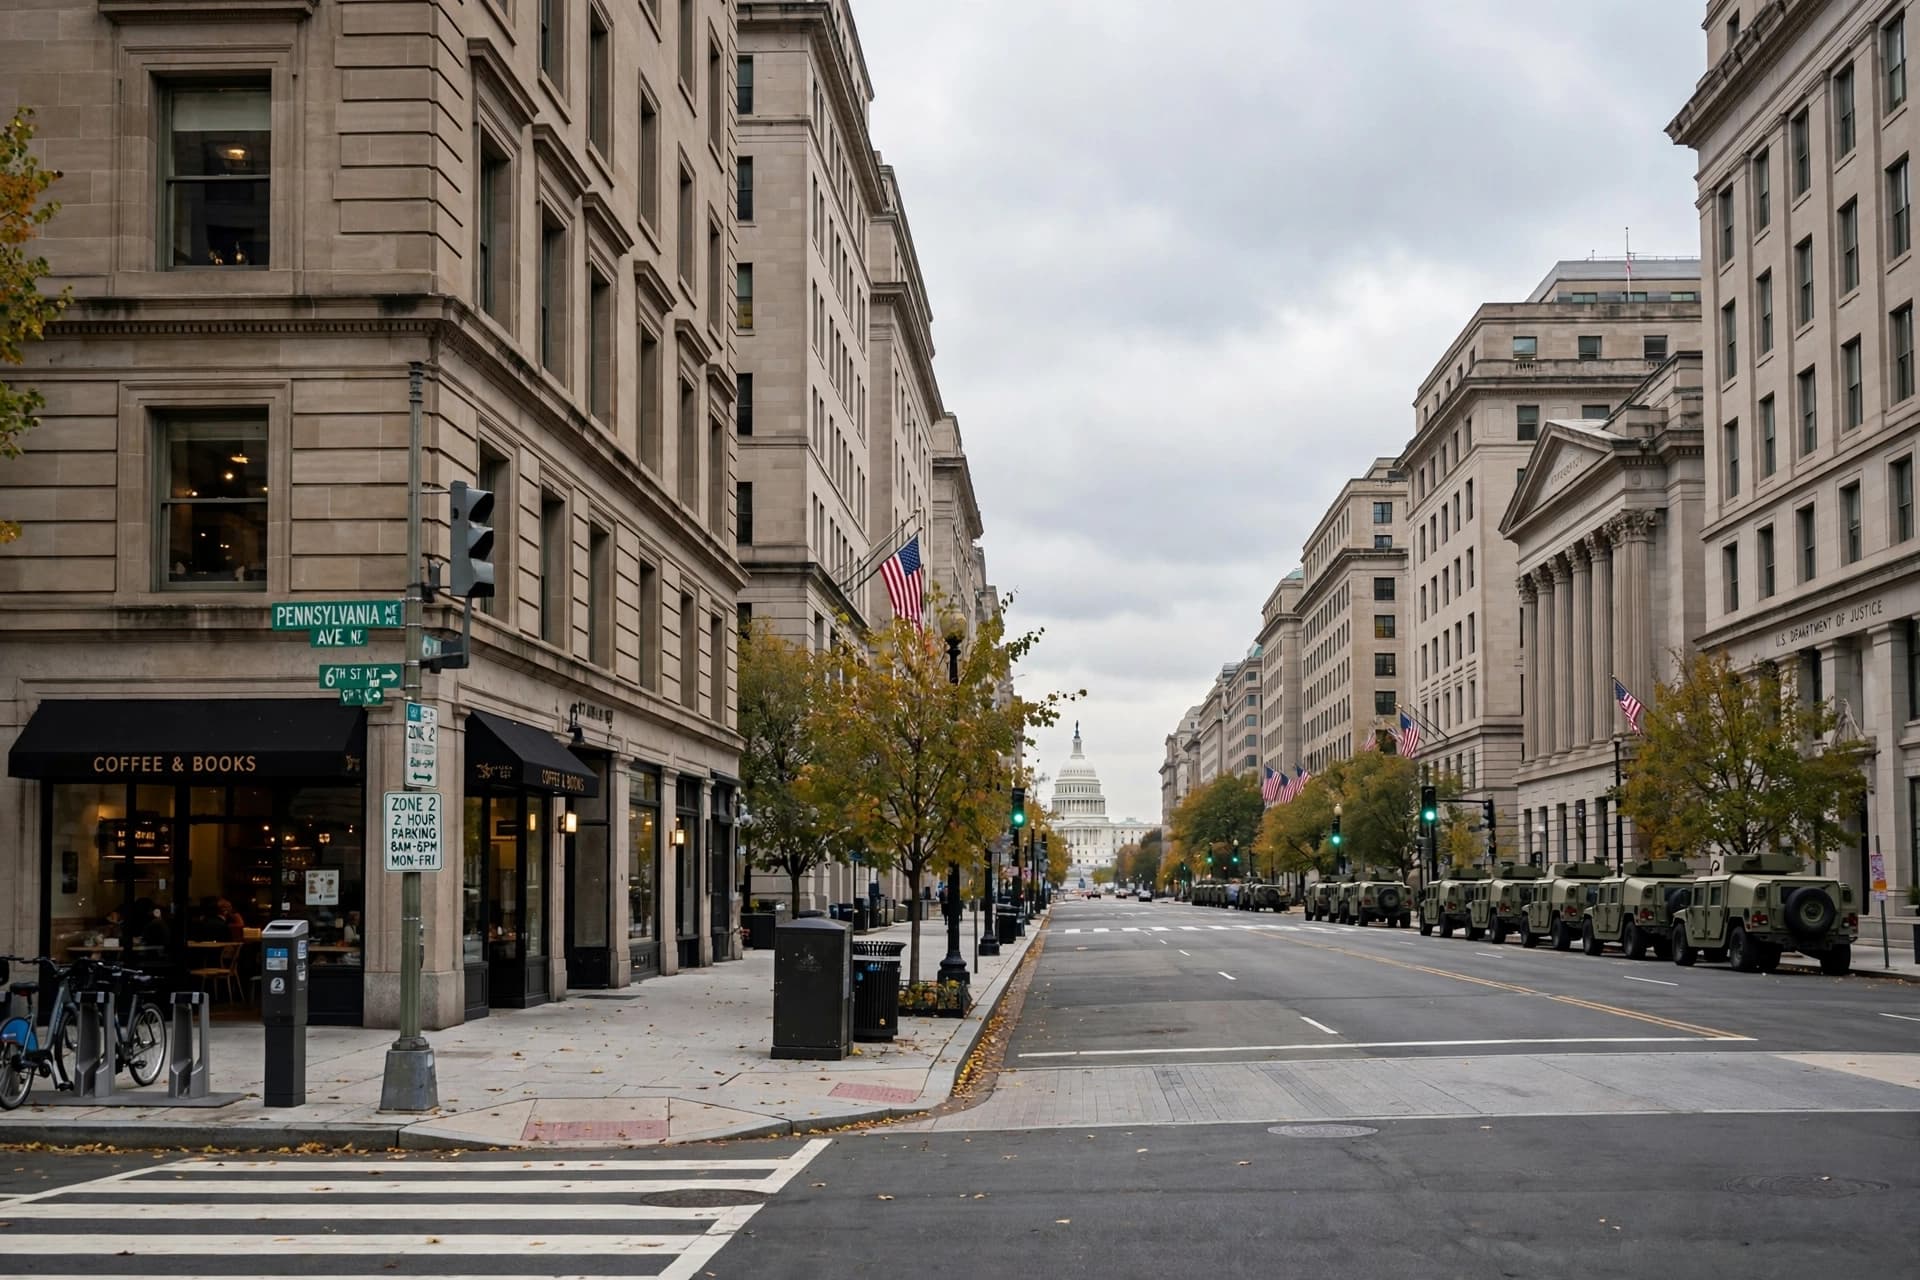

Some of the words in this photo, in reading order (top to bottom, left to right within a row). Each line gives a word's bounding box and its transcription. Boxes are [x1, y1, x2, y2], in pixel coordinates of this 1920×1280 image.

[276, 604, 380, 626] PENNSYLVANIA
[1836, 612, 1845, 627] OF
[1850, 599, 1883, 622] JUSTICE
[317, 628, 345, 645] AVE
[325, 667, 346, 687] 6TH
[350, 668, 361, 680] ST
[93, 756, 164, 772] COFFEE
[172, 756, 184, 772] &
[192, 755, 257, 772] BOOKS
[541, 768, 561, 786] COFFEE
[391, 797, 423, 811] ZONE
[428, 797, 436, 812] 2
[394, 815, 402, 826] 2
[408, 814, 436, 826] HOUR
[391, 827, 437, 839] PARKING
[391, 841, 437, 853] 8AM-6PM
[391, 854, 436, 866] MON-FRI
